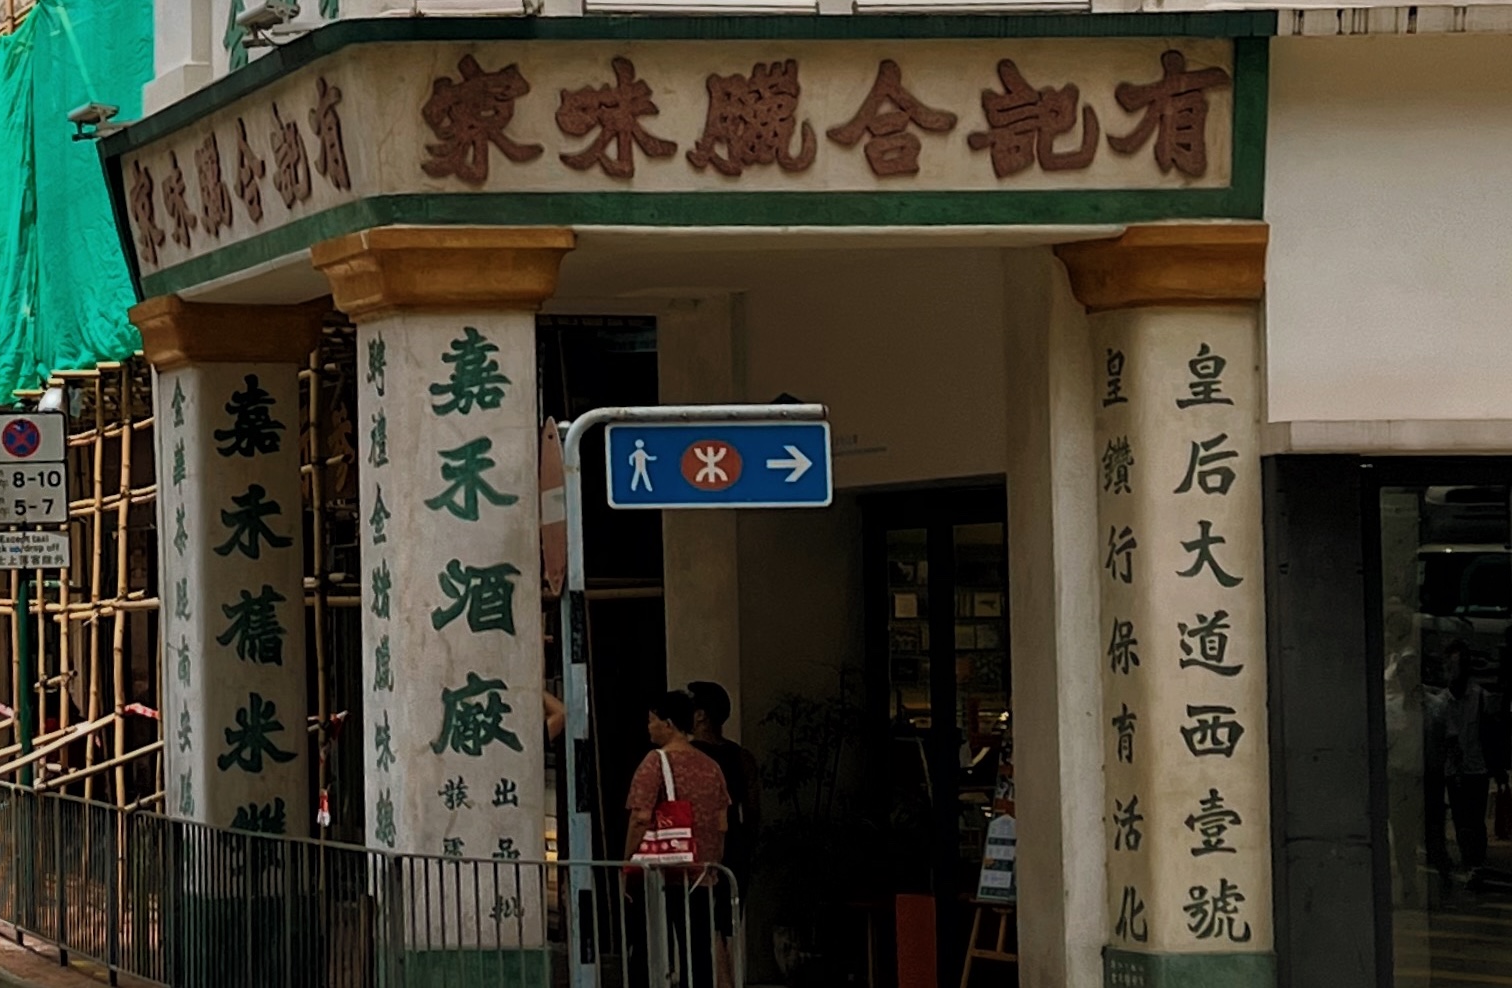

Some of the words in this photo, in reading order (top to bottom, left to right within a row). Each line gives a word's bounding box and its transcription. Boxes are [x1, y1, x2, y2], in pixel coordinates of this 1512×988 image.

[13, 471, 61, 488] 8-10
[425, 327, 524, 757] 嘉禾酒廠
[1173, 343, 1251, 943] 皇后大道西壹號
